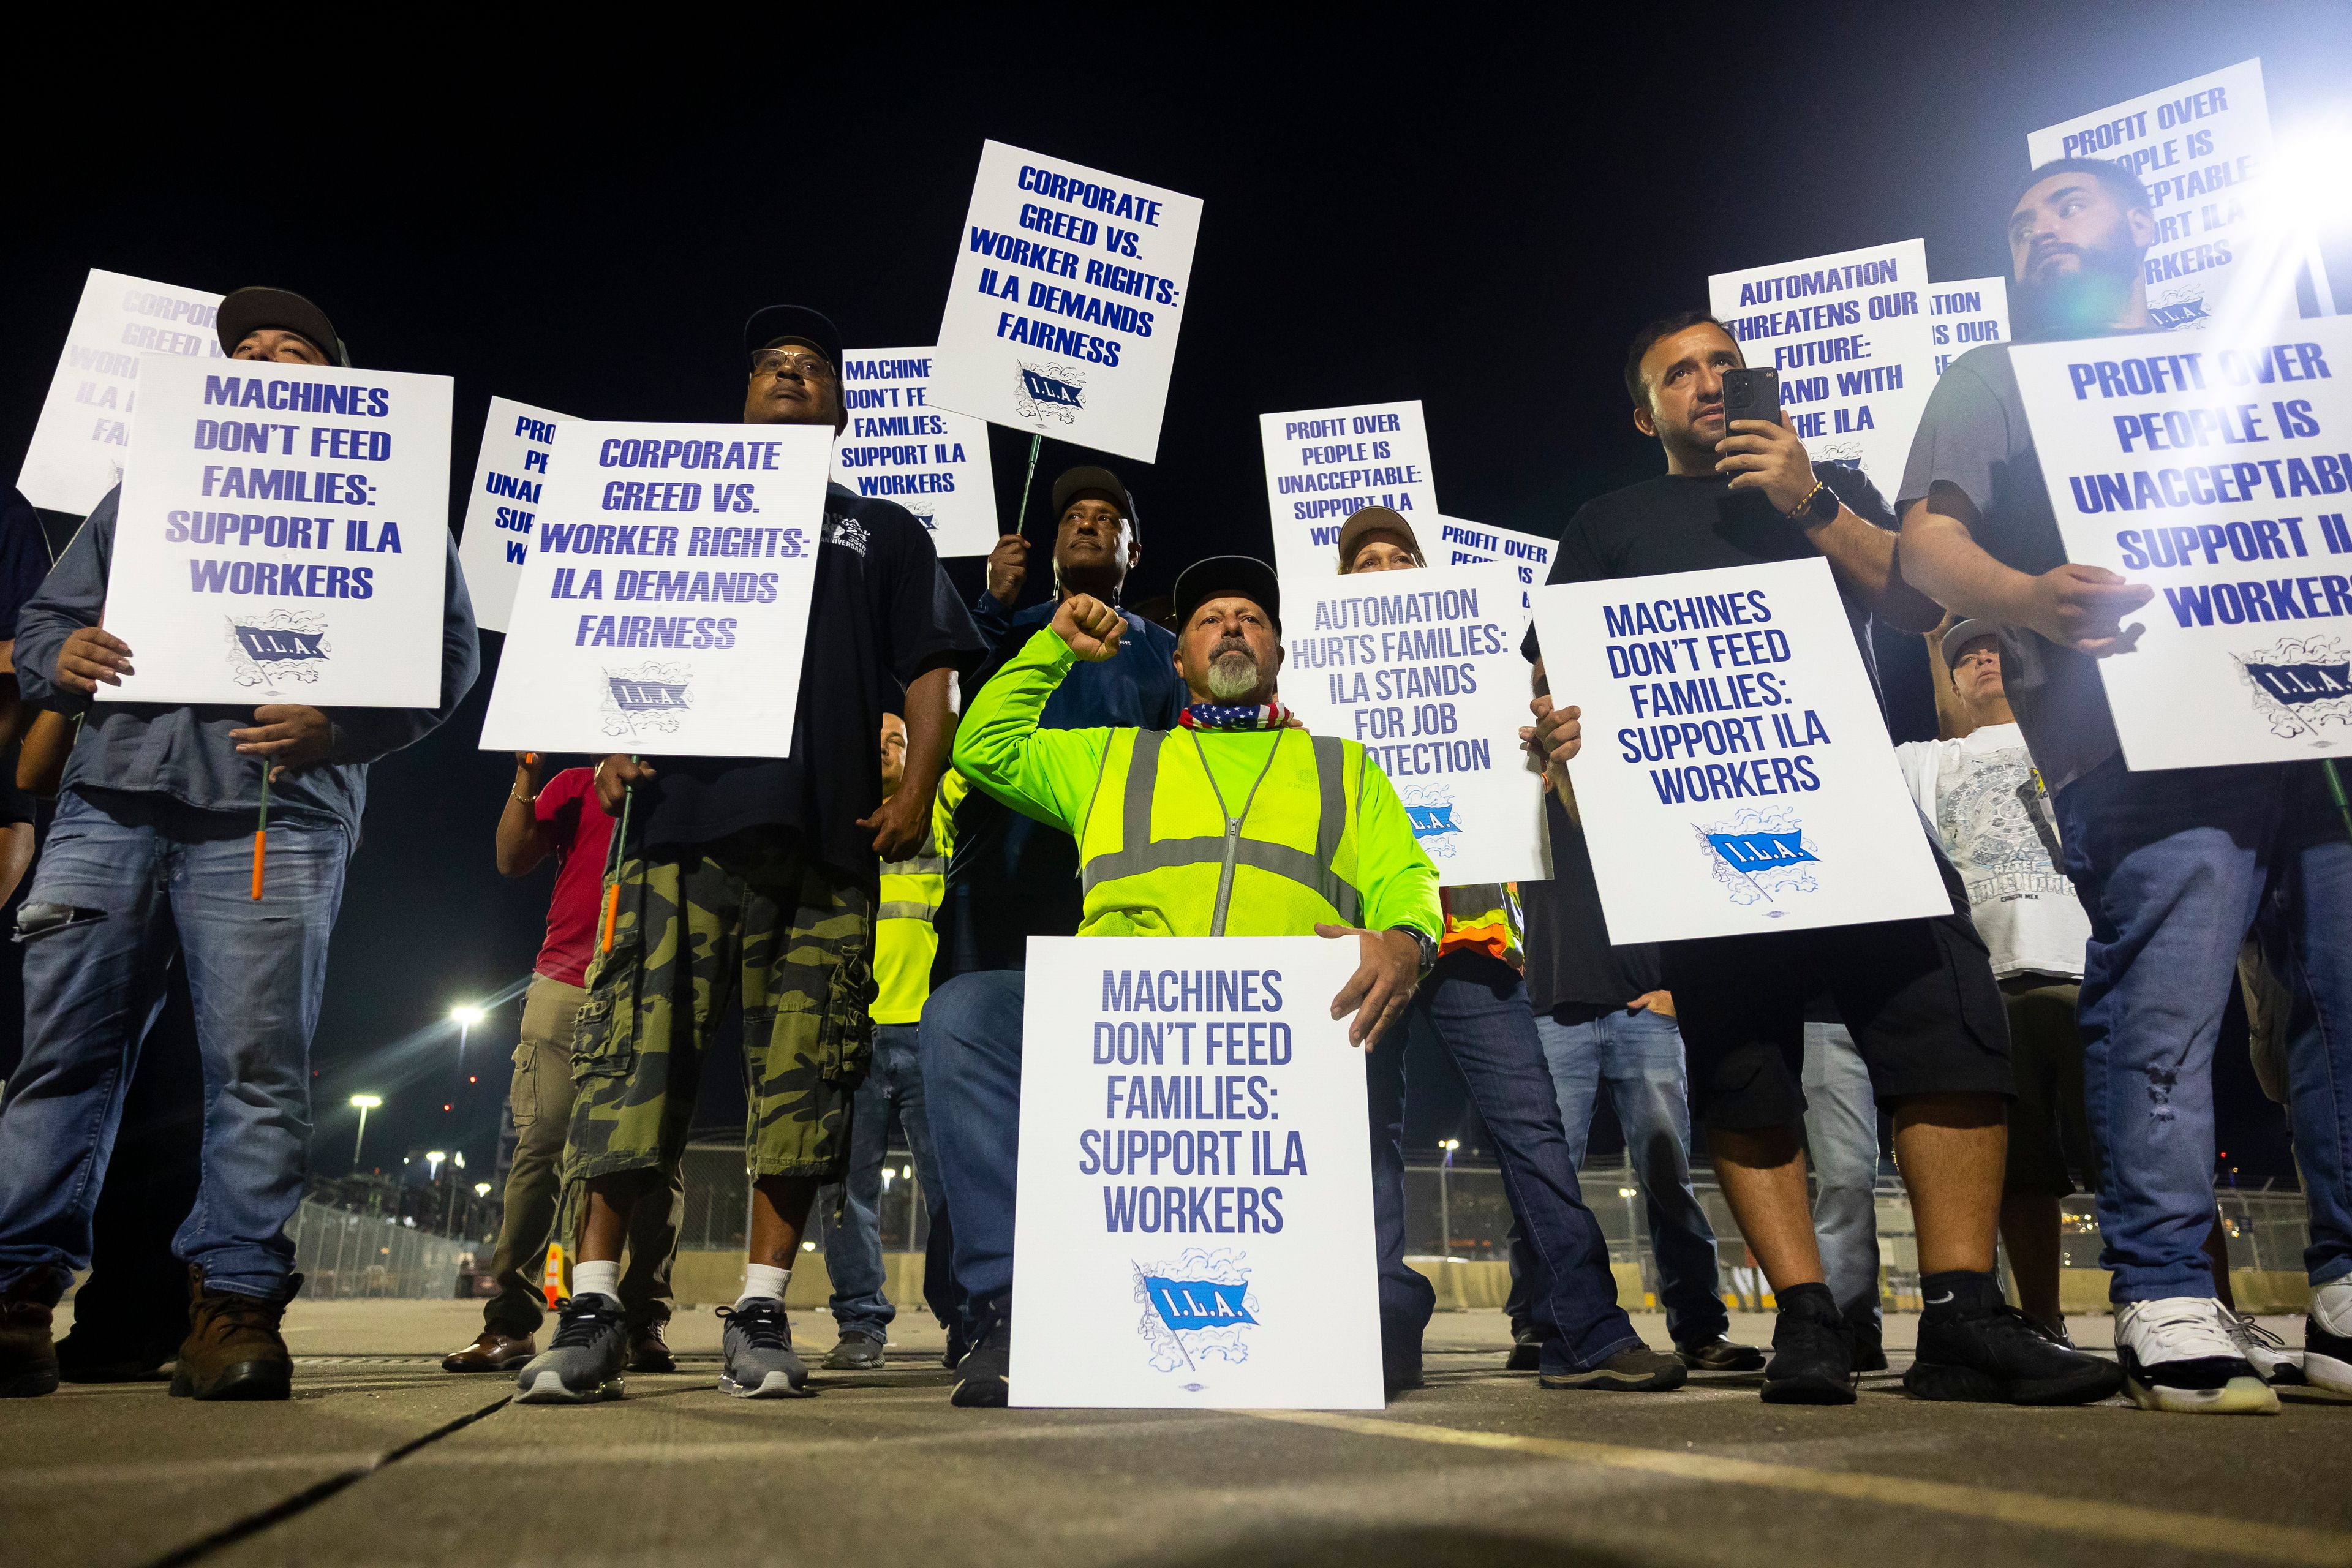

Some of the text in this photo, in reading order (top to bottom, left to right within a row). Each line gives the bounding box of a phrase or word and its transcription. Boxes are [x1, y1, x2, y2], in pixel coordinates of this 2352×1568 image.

[2062, 86, 2229, 160] PROFIT OVER
[2187, 128, 2214, 159] IS
[1017, 165, 1163, 227] CORPORATE
[2201, 197, 2249, 232] ILA
[1019, 203, 1142, 260] GREED VS.
[970, 226, 1180, 308] WORKER RIGHTS:
[1740, 258, 1898, 307] AUTOMATION
[2144, 239, 2233, 285] RKERS
[978, 268, 1154, 338] ILA DEMANDS
[1868, 290, 1920, 321] OUR
[121, 323, 202, 356] GREED
[997, 311, 1121, 368] FAIRNESS
[1774, 334, 1872, 371] FUTURE:
[1956, 320, 2000, 344] OUR
[845, 358, 933, 380] MACHINE
[1837, 364, 1904, 398] WITH
[2068, 342, 2332, 400] PROFIT OVER
[75, 381, 118, 410] ILA
[203, 375, 389, 418] MACHINES
[1031, 377, 1077, 405] I.L.A.
[194, 419, 392, 462] DON'T FEED
[854, 415, 948, 438] FAMILIES:
[1286, 413, 1401, 440] PROFIT OVER
[1834, 405, 1875, 435] ILA
[2113, 399, 2321, 453] PEOPLE IS
[598, 439, 783, 470] CORPORATE
[842, 443, 966, 467] SUPPORT ILA
[1302, 440, 1391, 466] PEOPLE IS
[202, 466, 377, 507] FAMILIES:
[601, 481, 760, 513] GREED VS.
[858, 472, 955, 496] WORKERS
[1278, 465, 1423, 495] UNACCEPTABLE:
[165, 510, 402, 554] SUPPORT ILA
[540, 523, 679, 556] WORKER
[689, 527, 810, 558] RIGHTS:
[820, 537, 865, 557] ANNIVERSARY
[1442, 525, 1499, 552] PROFIT
[1504, 540, 1548, 564] OVER
[2117, 517, 2309, 570] SUPPORT
[190, 559, 374, 600] WORKERS
[551, 568, 779, 603] ILA DEMANDS
[1314, 587, 1480, 631] AUTOMATION
[1603, 590, 1772, 638] MACHINES
[2163, 575, 2352, 628] WORKER
[250, 633, 317, 655] I.L.A.
[575, 614, 737, 649] FAIRNESS
[1292, 622, 1509, 669] HURTS FAMILIES:
[1606, 628, 1792, 679] DON'T FEED
[621, 685, 680, 704] I.L.A.
[1329, 663, 1477, 704] ILA STANDS
[1629, 671, 1792, 720] FAMILIES:
[1354, 702, 1458, 741] FOR JOB
[1618, 709, 1831, 764] SUPPORT ILA
[1649, 754, 1821, 805] WORKERS
[1724, 837, 1804, 863] I.L.A.
[1101, 970, 1283, 1012] MACHINES
[1093, 1022, 1292, 1066] DON'T FEED
[1106, 1075, 1278, 1120] FAMILIES:
[1079, 1129, 1308, 1177] SUPPORT ILA
[1102, 1186, 1284, 1234] WORKERS
[1161, 1289, 1243, 1317] I.L.A.
